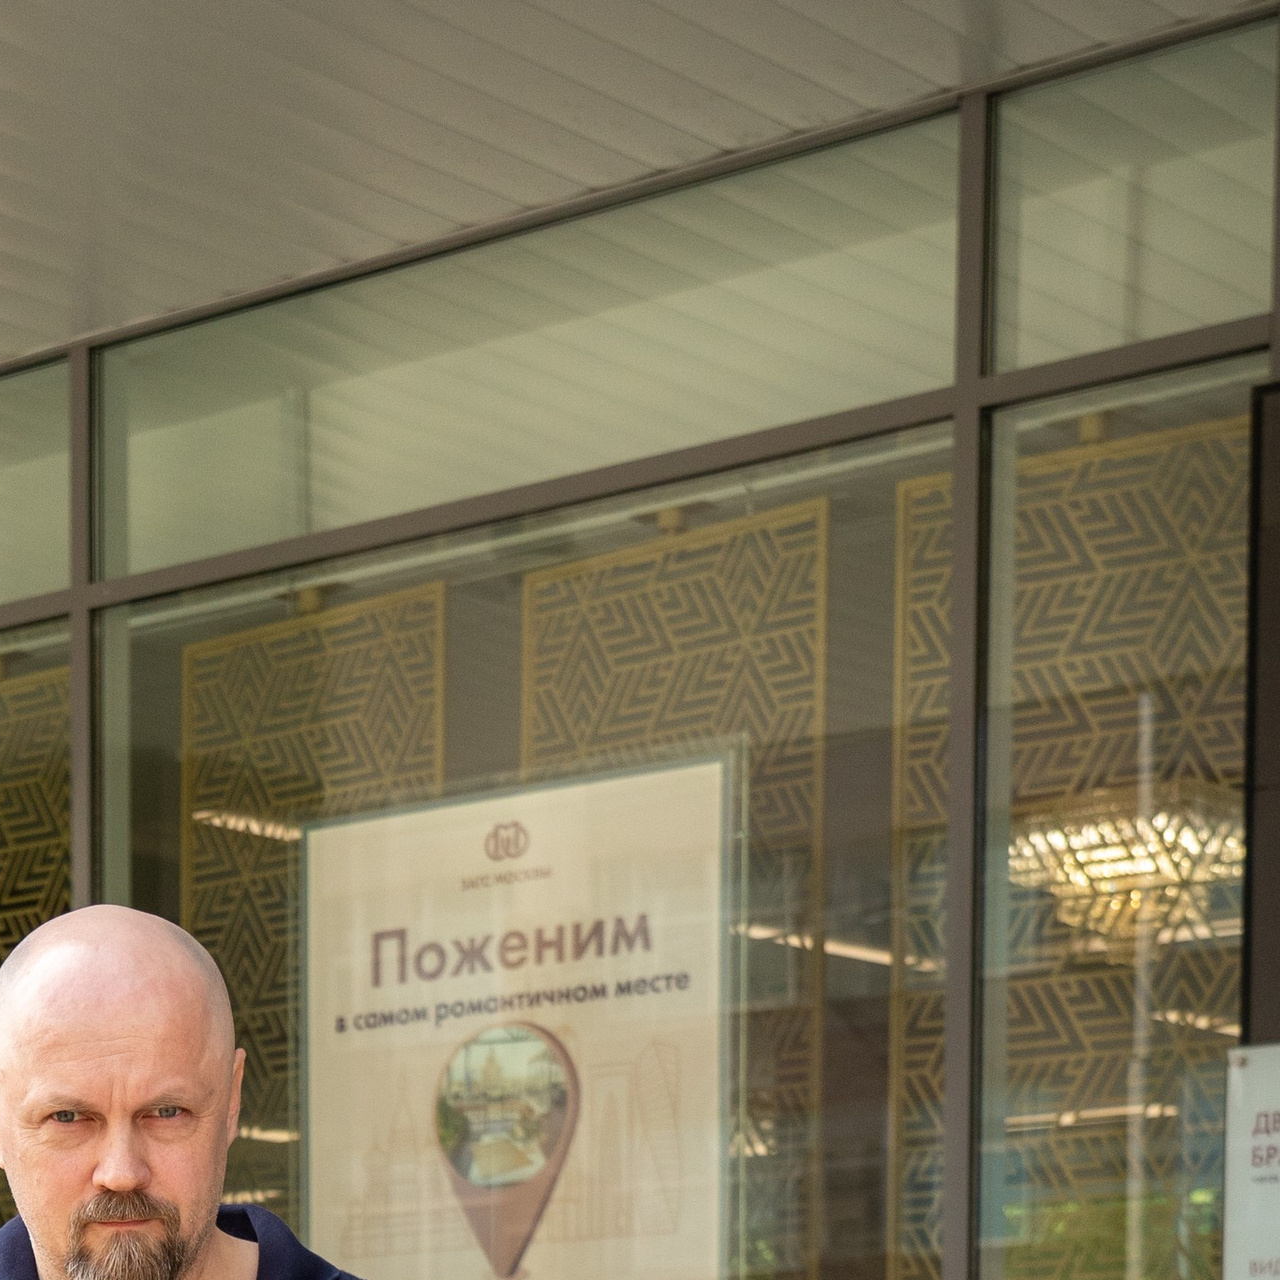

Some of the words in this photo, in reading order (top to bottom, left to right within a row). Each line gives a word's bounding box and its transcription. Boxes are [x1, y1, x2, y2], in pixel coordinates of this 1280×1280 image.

[372, 913, 652, 987] Поженим
[352, 1006, 429, 1030] самом
[434, 984, 608, 1026] романтичном
[614, 972, 691, 997] месте
